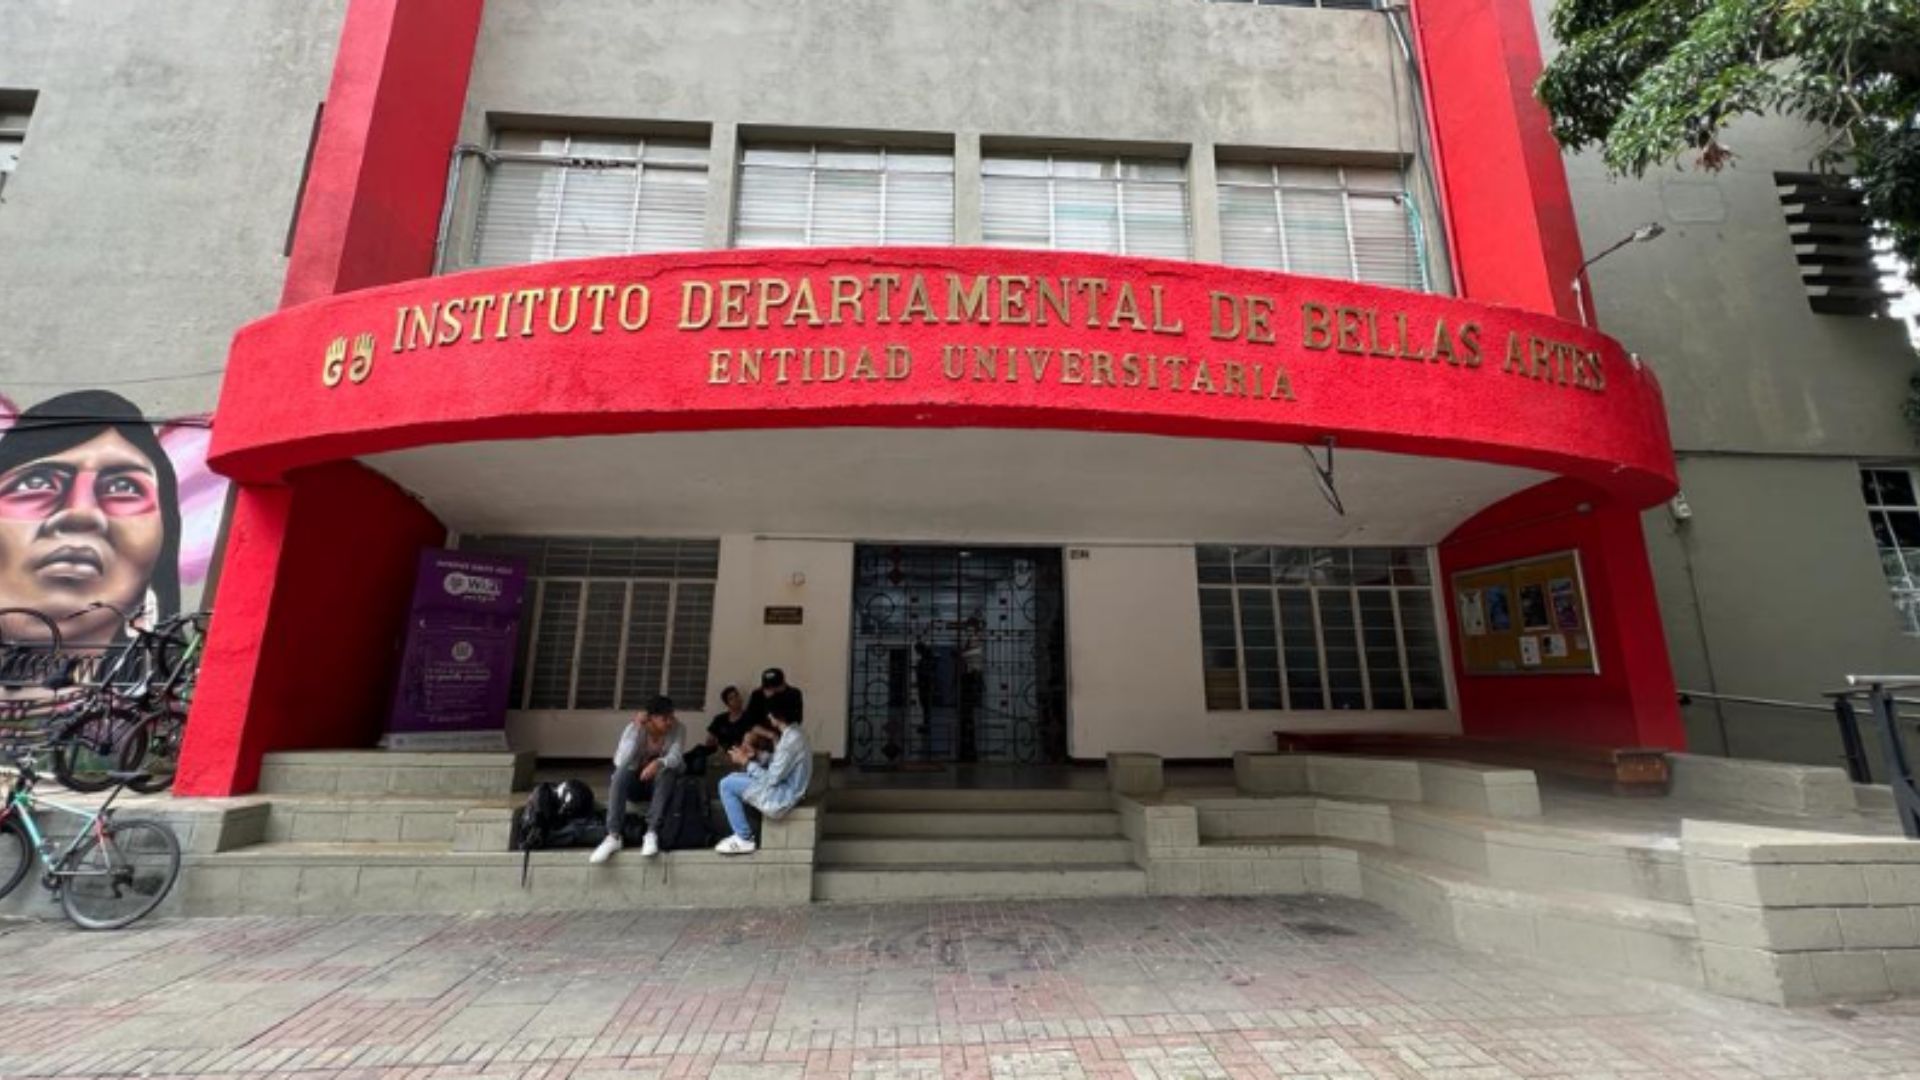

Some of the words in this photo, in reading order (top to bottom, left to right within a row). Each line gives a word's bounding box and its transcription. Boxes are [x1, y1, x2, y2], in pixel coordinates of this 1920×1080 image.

[393, 284, 649, 351] INSTITUTO
[678, 274, 1183, 332] DEPARTAMENTAL
[1211, 291, 1276, 343] DE
[1302, 302, 1483, 367] BELLAS
[1504, 331, 1606, 391] ARTES
[709, 346, 912, 384] ENTIDAD
[943, 345, 1297, 401] UNIVERSITARIA
